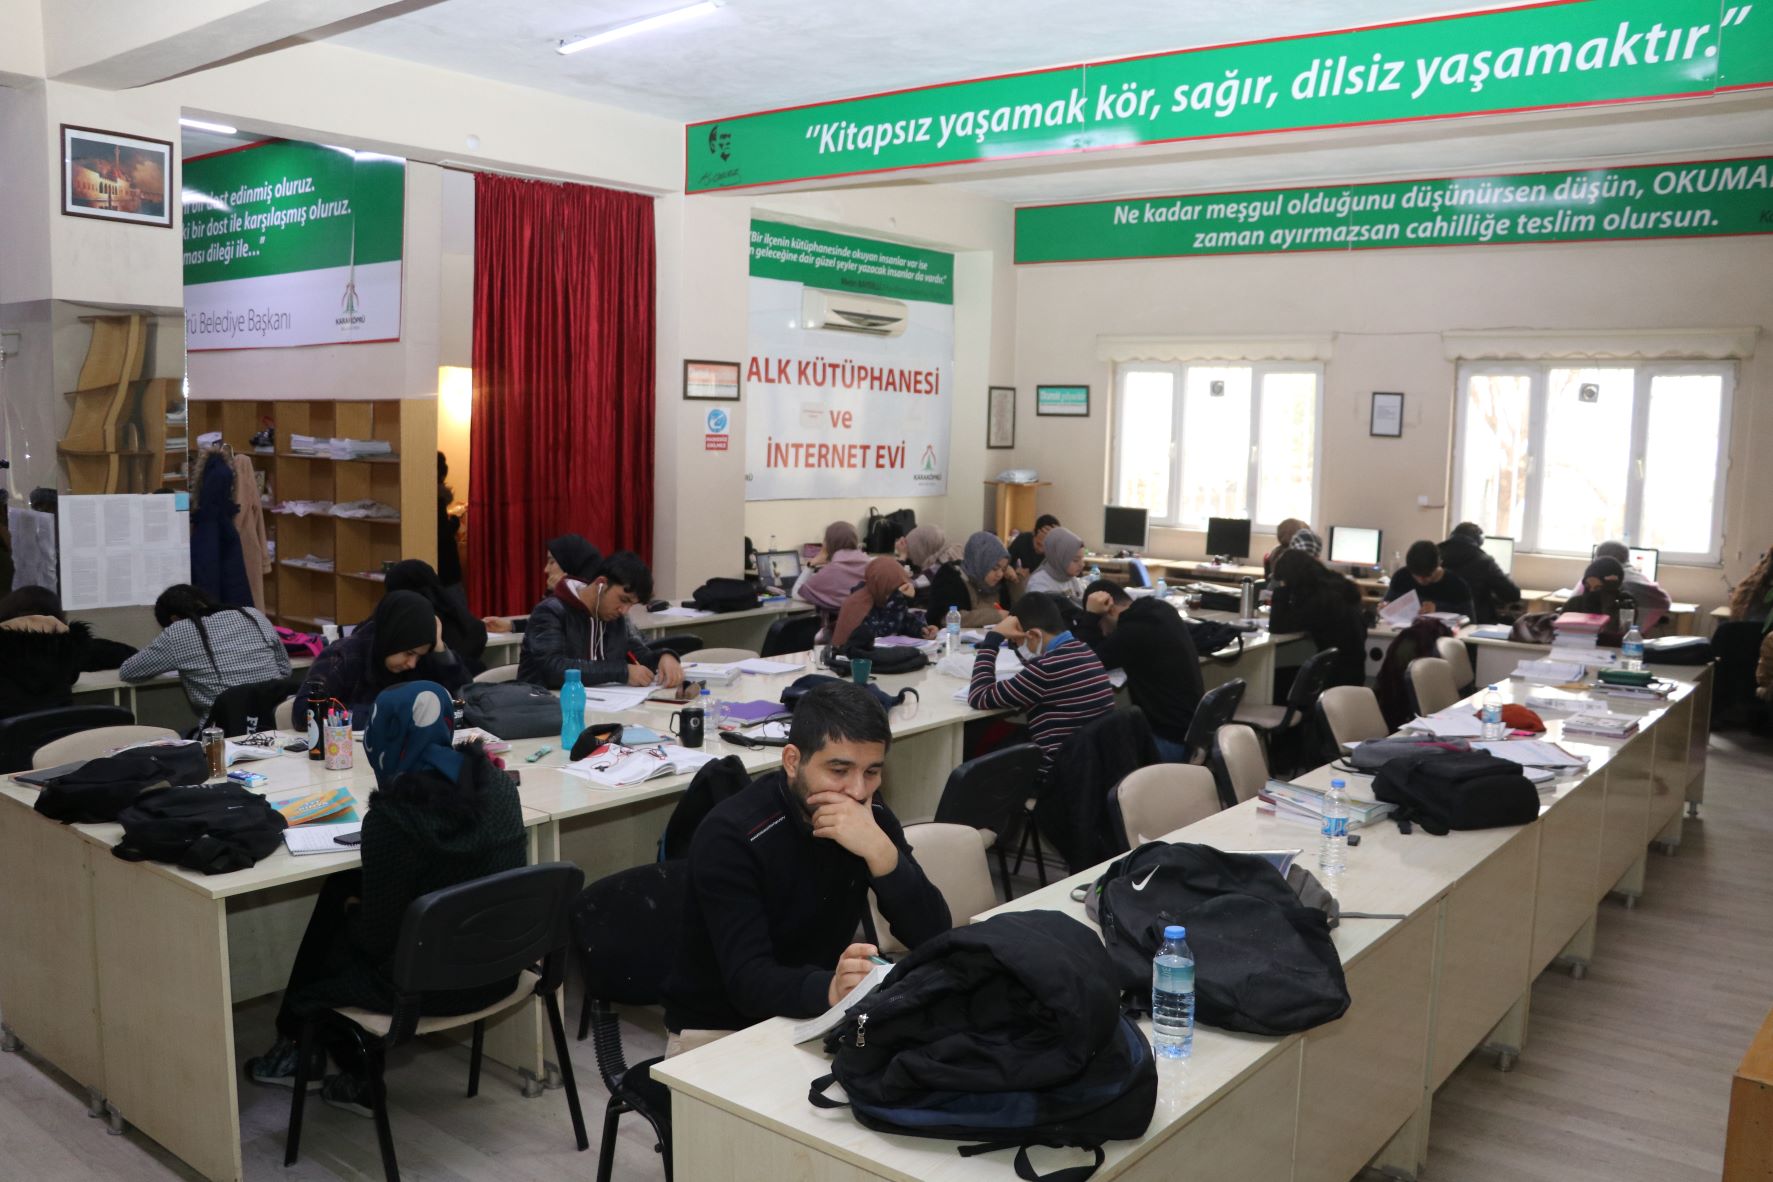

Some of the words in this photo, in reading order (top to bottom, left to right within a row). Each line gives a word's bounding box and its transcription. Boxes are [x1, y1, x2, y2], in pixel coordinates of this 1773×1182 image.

[938, 88, 1088, 148] yaşamak
[1095, 81, 1162, 121] kör,
[1171, 69, 1280, 118] sağır,
[1291, 52, 1406, 101] dilsiz
[230, 180, 273, 205] edinmiş
[274, 176, 315, 198] oluruz.
[1113, 205, 1140, 225] Ne
[1143, 200, 1203, 223] kadar
[1205, 194, 1284, 223] meşgul
[1286, 190, 1396, 217] olduğunu
[1401, 182, 1547, 212] düşünürsen
[1553, 176, 1645, 205] düşün,
[1653, 164, 1773, 196] OKUMA
[191, 218, 205, 239] bir
[206, 217, 228, 236] dost
[229, 213, 242, 231] ile
[244, 206, 307, 233] karşılaşmış
[309, 199, 352, 221] oluruz.
[1193, 229, 1265, 248] zaman
[1269, 222, 1400, 249] ayırmazsan
[1405, 213, 1509, 241] cahilliğe
[1516, 209, 1596, 235] teslim
[1602, 207, 1720, 231] olursun.
[206, 241, 234, 265] dileği
[756, 247, 799, 262] geleceğine
[799, 251, 815, 264] dair
[815, 255, 836, 268] güzel
[836, 259, 858, 271] şeyler
[857, 263, 887, 275] yazacak
[886, 266, 915, 279] insanlar
[915, 270, 924, 282] da
[763, 232, 790, 247] ilçenin
[790, 236, 851, 258] kütüphanesinde
[852, 249, 879, 263] okuyan
[879, 252, 907, 266] insanlar
[906, 259, 919, 269] var
[919, 259, 929, 270] ise
[200, 310, 246, 339] Belediye
[247, 307, 291, 337] Başkanı
[746, 356, 792, 385] ALK
[797, 356, 940, 396] KÜTÜPHANESİ
[829, 410, 853, 429] ve
[766, 436, 871, 469] İNTERNET
[875, 439, 906, 469] EVİ
